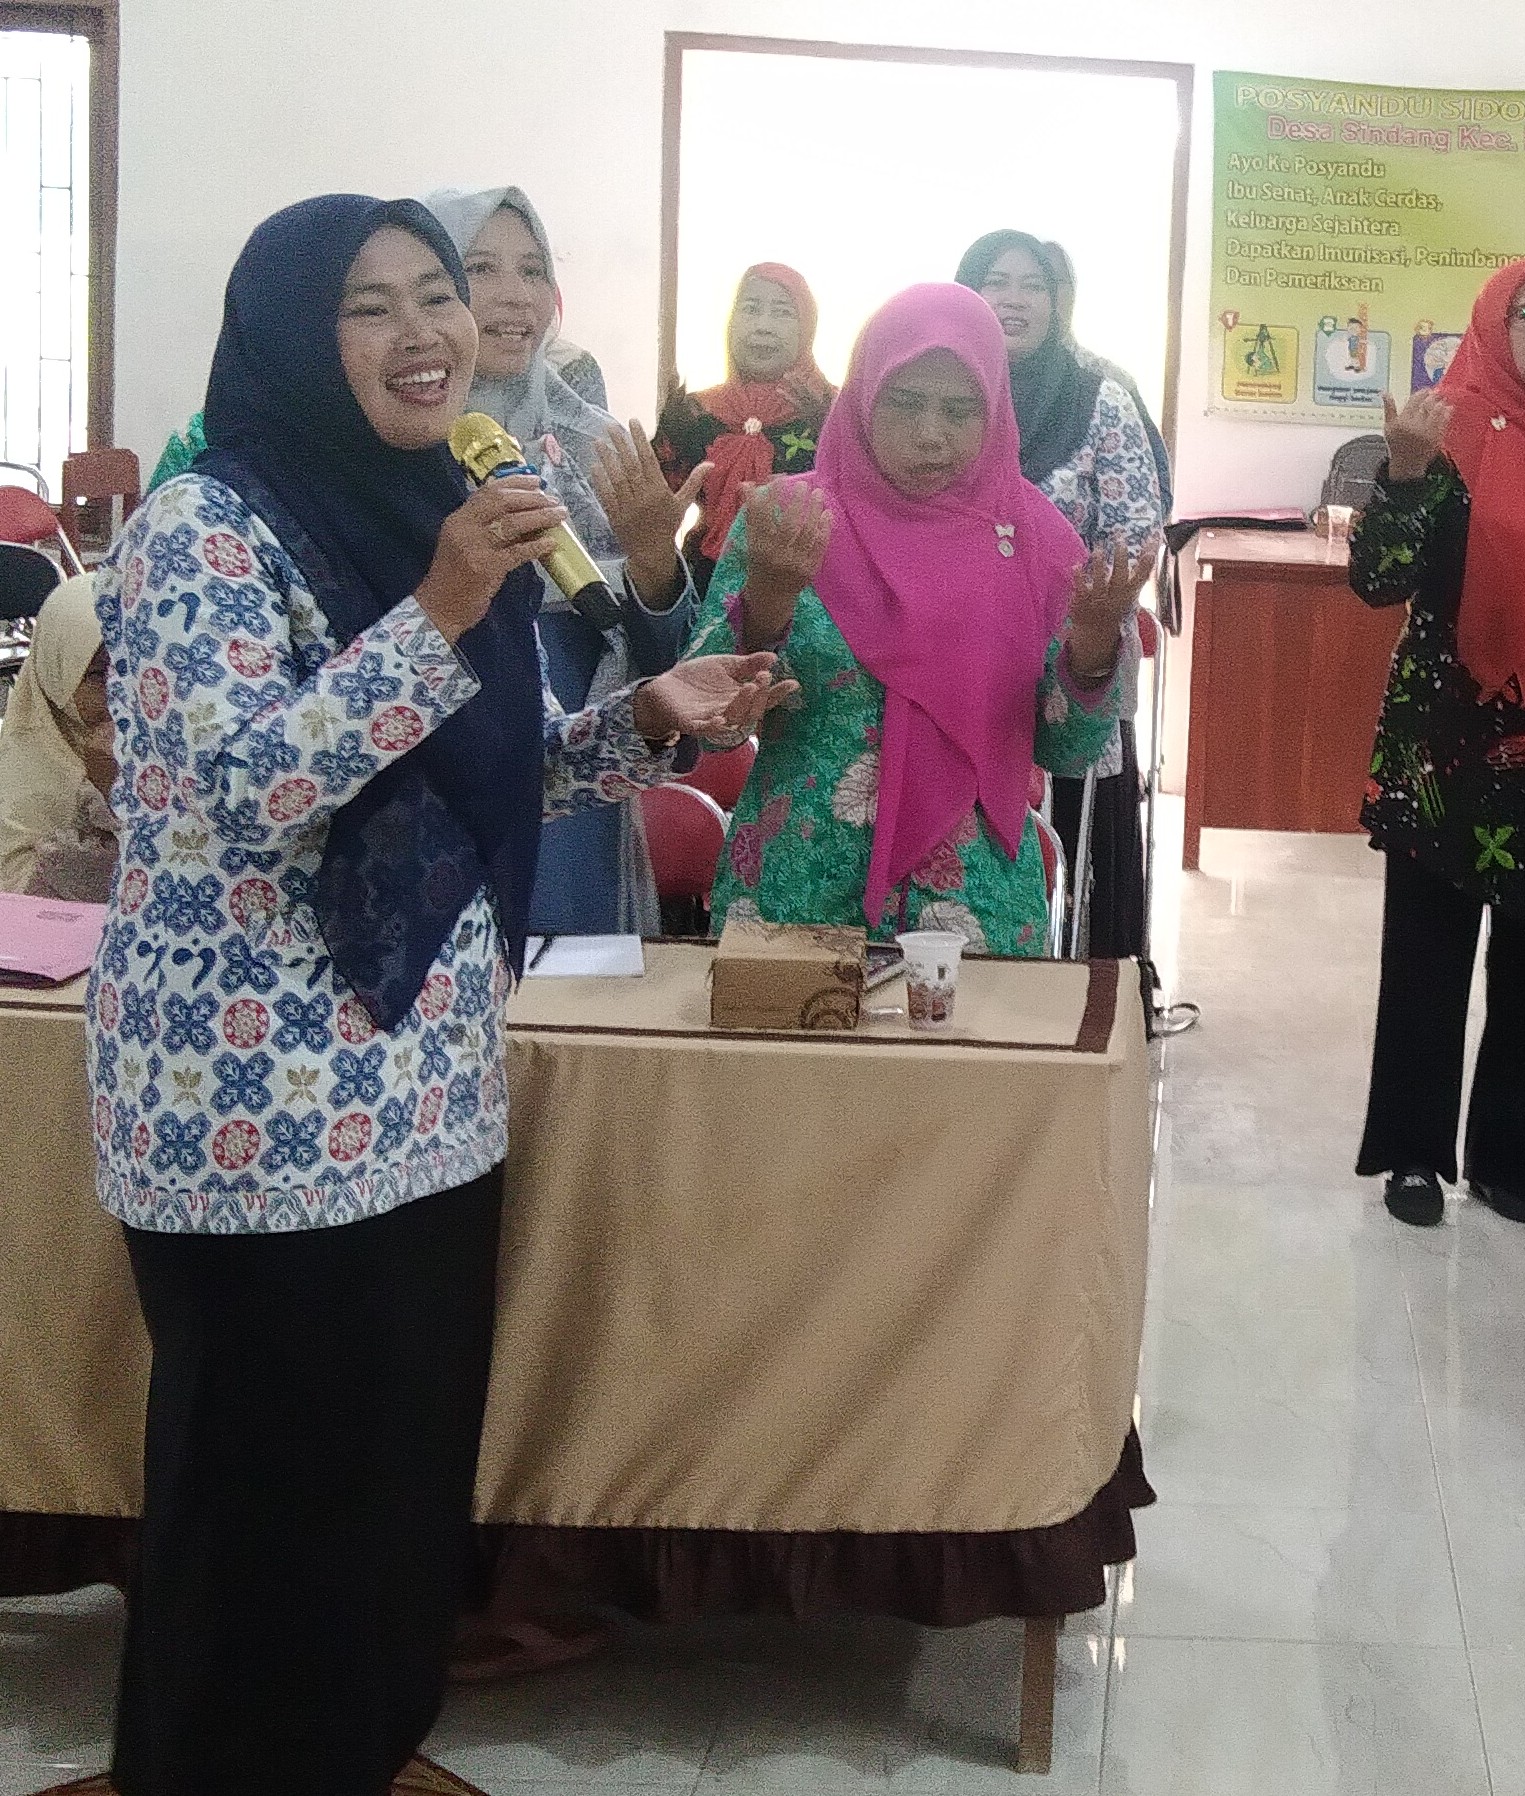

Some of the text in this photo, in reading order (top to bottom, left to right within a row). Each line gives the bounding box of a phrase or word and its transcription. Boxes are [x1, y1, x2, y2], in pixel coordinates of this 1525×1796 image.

[1236, 86, 1432, 120] POSYANDU
[1267, 115, 1334, 142] Desa
[1340, 120, 1451, 152] Sindang
[1458, 126, 1518, 151] Kec.
[1228, 152, 1386, 179] Ayo Ke Posyandu
[1227, 180, 1257, 200] Ibu
[1321, 187, 1370, 206] Anak
[1374, 189, 1443, 211] Cerdas,
[1226, 209, 1401, 237] Keluarga Sejahtera
[1226, 238, 1314, 262] Dapatkan
[1317, 243, 1411, 267] Imunisasi,
[1226, 266, 1384, 293] Dan Pemeriksaan
